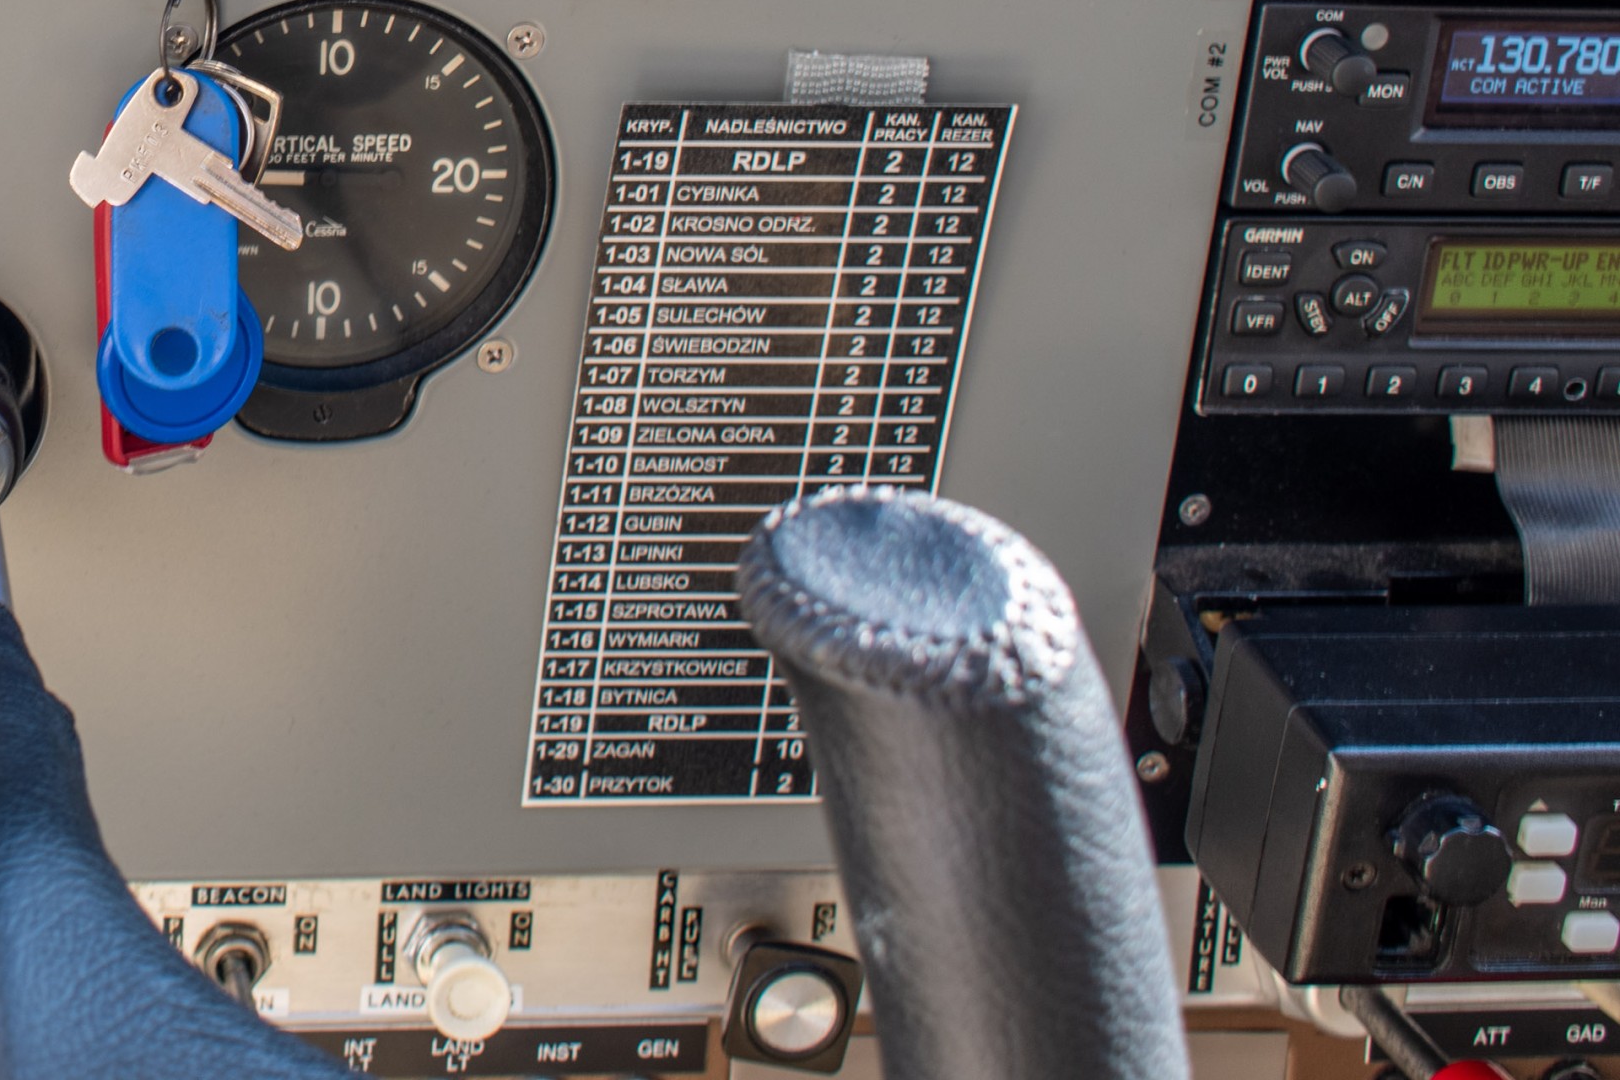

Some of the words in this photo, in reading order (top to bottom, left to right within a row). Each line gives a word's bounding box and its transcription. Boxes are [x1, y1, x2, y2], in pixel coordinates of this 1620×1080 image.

[1316, 10, 1344, 21] COM
[319, 39, 355, 76] 10
[1211, 43, 1227, 68] #2
[1476, 35, 1620, 75] 130.780
[1263, 69, 1288, 80] VOL
[1367, 84, 1404, 98] MON
[1470, 78, 1506, 94] COM
[1514, 77, 1586, 95] ACTIVE
[1198, 73, 1227, 127] COM
[625, 120, 675, 135] KRYP.
[704, 118, 848, 136] NADLEŚNICTWO
[885, 113, 923, 128] KAN.
[952, 113, 989, 128] KAN.
[1295, 120, 1324, 133] NAV
[353, 133, 412, 153] SPEED
[873, 128, 929, 143] PRACY
[941, 128, 994, 143] REZER
[322, 153, 347, 164] PER
[350, 152, 394, 163] MINUTE
[618, 152, 670, 171] 1-19
[731, 150, 807, 173] RDLP
[883, 150, 904, 173] 2
[947, 153, 976, 172] 12
[431, 158, 480, 194] 20
[1397, 175, 1424, 188] C/N
[1484, 175, 1516, 189] OBS
[1580, 175, 1602, 190] T/F
[614, 184, 660, 203] 1-01
[675, 185, 761, 203] CYBINKA
[305, 221, 347, 238] Cessna
[670, 216, 754, 233] KROSNO
[757, 216, 817, 233] ODRZ.
[1244, 227, 1304, 243] GARMIN
[665, 246, 728, 264] NOWA
[730, 244, 770, 264] SÓL
[1350, 249, 1374, 265] ON
[1246, 265, 1290, 279] IDENT
[661, 276, 729, 294] SŁAWA
[307, 281, 341, 316] 10
[1344, 292, 1372, 306] ALT
[656, 304, 767, 324] SULECHÓW
[1246, 314, 1275, 328] VFR
[651, 335, 771, 355] ŚWIEBODZIN
[646, 367, 727, 385] TORZYM
[641, 397, 747, 414] WOLSZTYN
[636, 426, 718, 444] ZIELONA
[720, 424, 776, 444] GÓRA
[632, 456, 729, 473] BABIMOST
[623, 516, 683, 532] GUBIN
[619, 544, 684, 562] LIPINKI
[615, 574, 690, 591] LUBSKO
[610, 603, 728, 620] SZPROTAWA
[607, 631, 701, 648] WYMIARKI
[603, 660, 750, 677] KRZYSTKOWICE
[599, 689, 679, 705] BYTNICA
[539, 715, 583, 732] 1-19
[647, 714, 708, 732] RDLP
[531, 777, 575, 794] 1-30
[588, 776, 674, 793] PRZYTOK
[196, 886, 285, 904] BEACON
[385, 884, 443, 900] LAND
[455, 881, 530, 901] LIGHTS
[1473, 1026, 1511, 1046] ATT
[1566, 1024, 1607, 1044] GAD
[537, 1042, 581, 1062] INST
[637, 1039, 679, 1057] GEN
